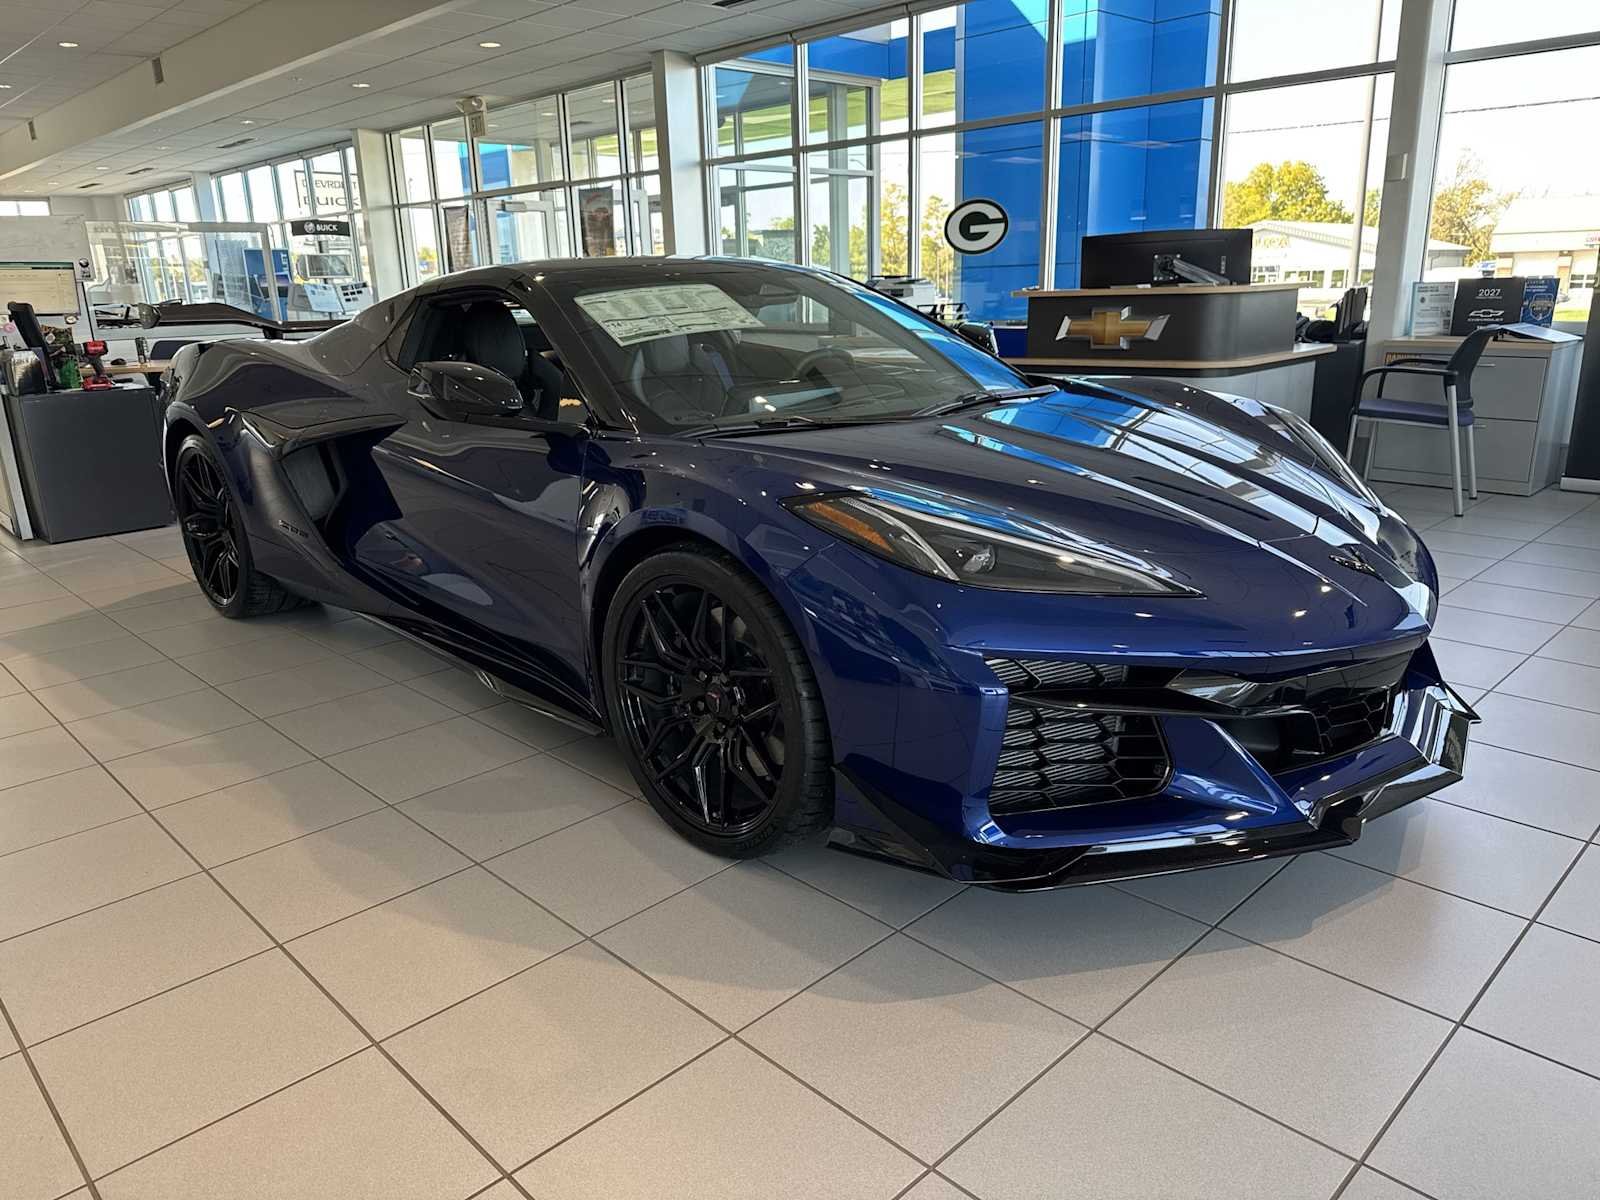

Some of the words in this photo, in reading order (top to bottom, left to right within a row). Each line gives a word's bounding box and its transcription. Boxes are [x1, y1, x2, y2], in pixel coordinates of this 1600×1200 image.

[316, 223, 338, 232] BUICK
[945, 200, 1007, 253] G
[1478, 288, 1501, 297] 2027
